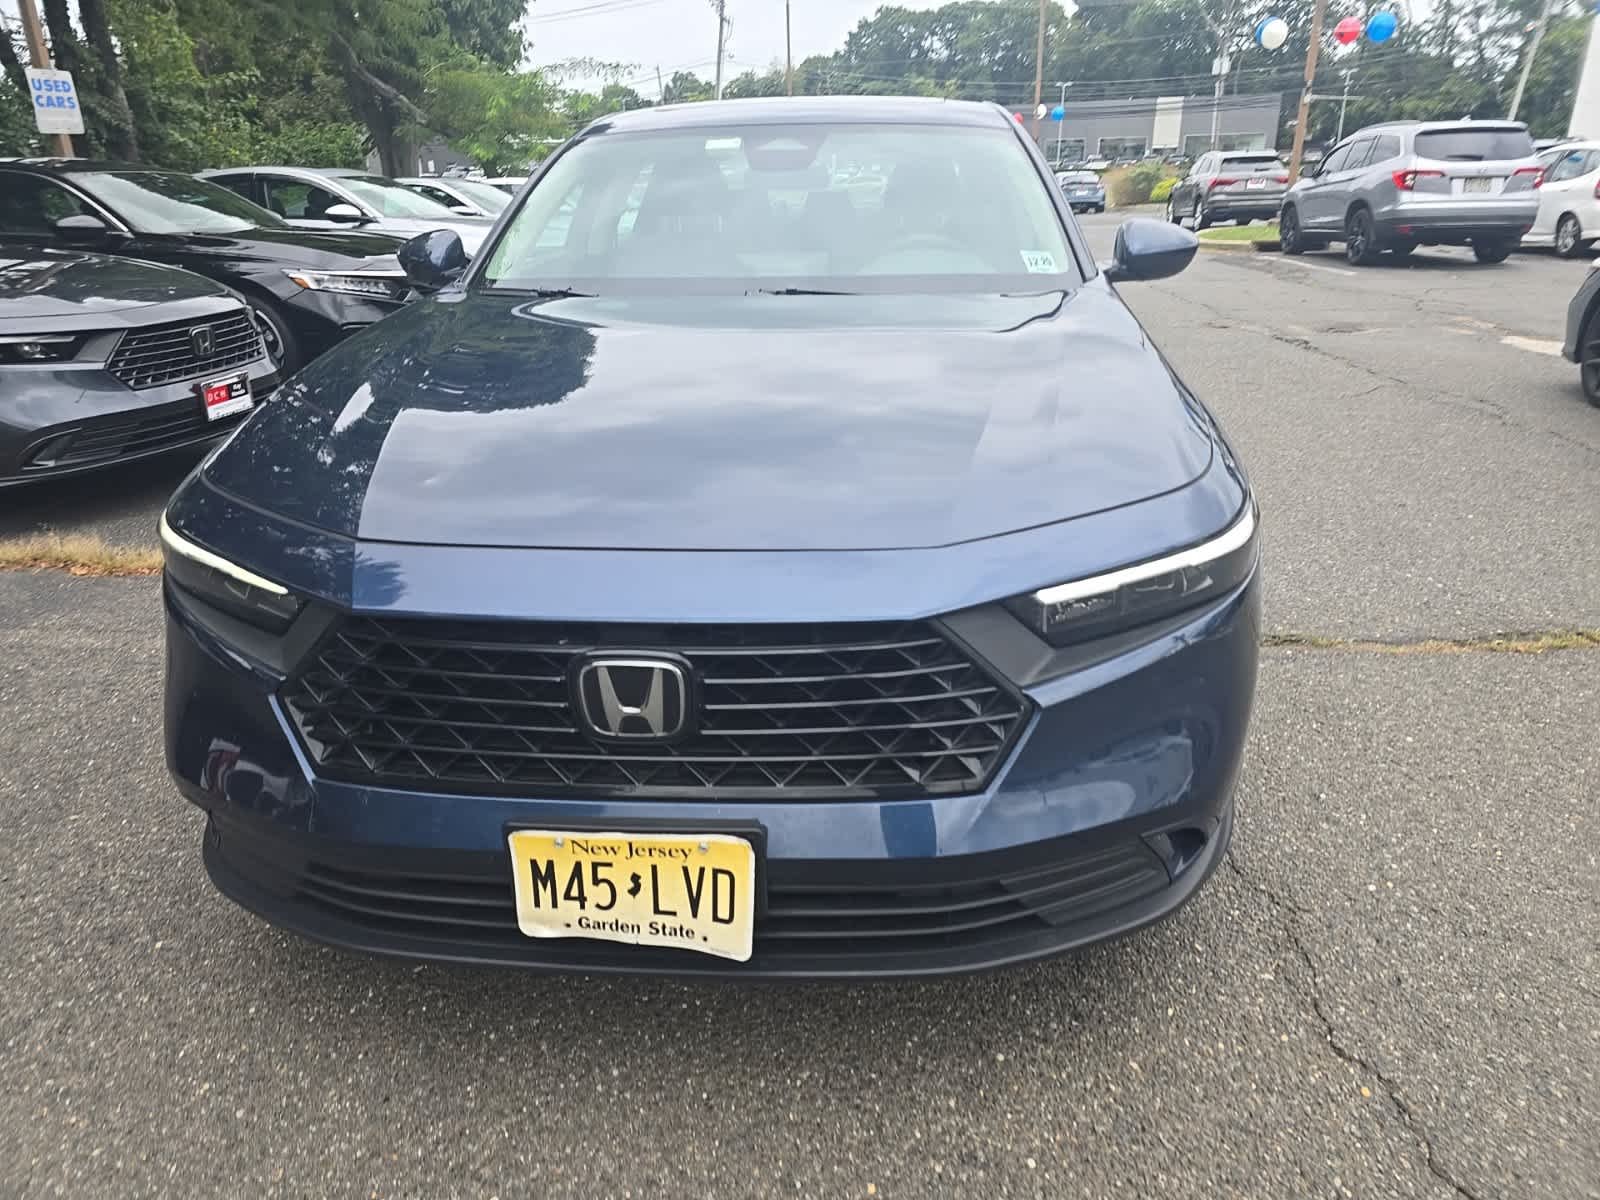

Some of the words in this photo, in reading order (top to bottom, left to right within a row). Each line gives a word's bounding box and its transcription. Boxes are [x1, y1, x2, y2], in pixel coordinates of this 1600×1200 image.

[31, 78, 71, 92] USED
[35, 94, 76, 109] CARS
[571, 839, 621, 856] New
[625, 841, 692, 862] Jersey
[529, 858, 617, 912] M45
[651, 863, 736, 925] LVD
[577, 916, 641, 935] Garden
[648, 920, 696, 940] State
